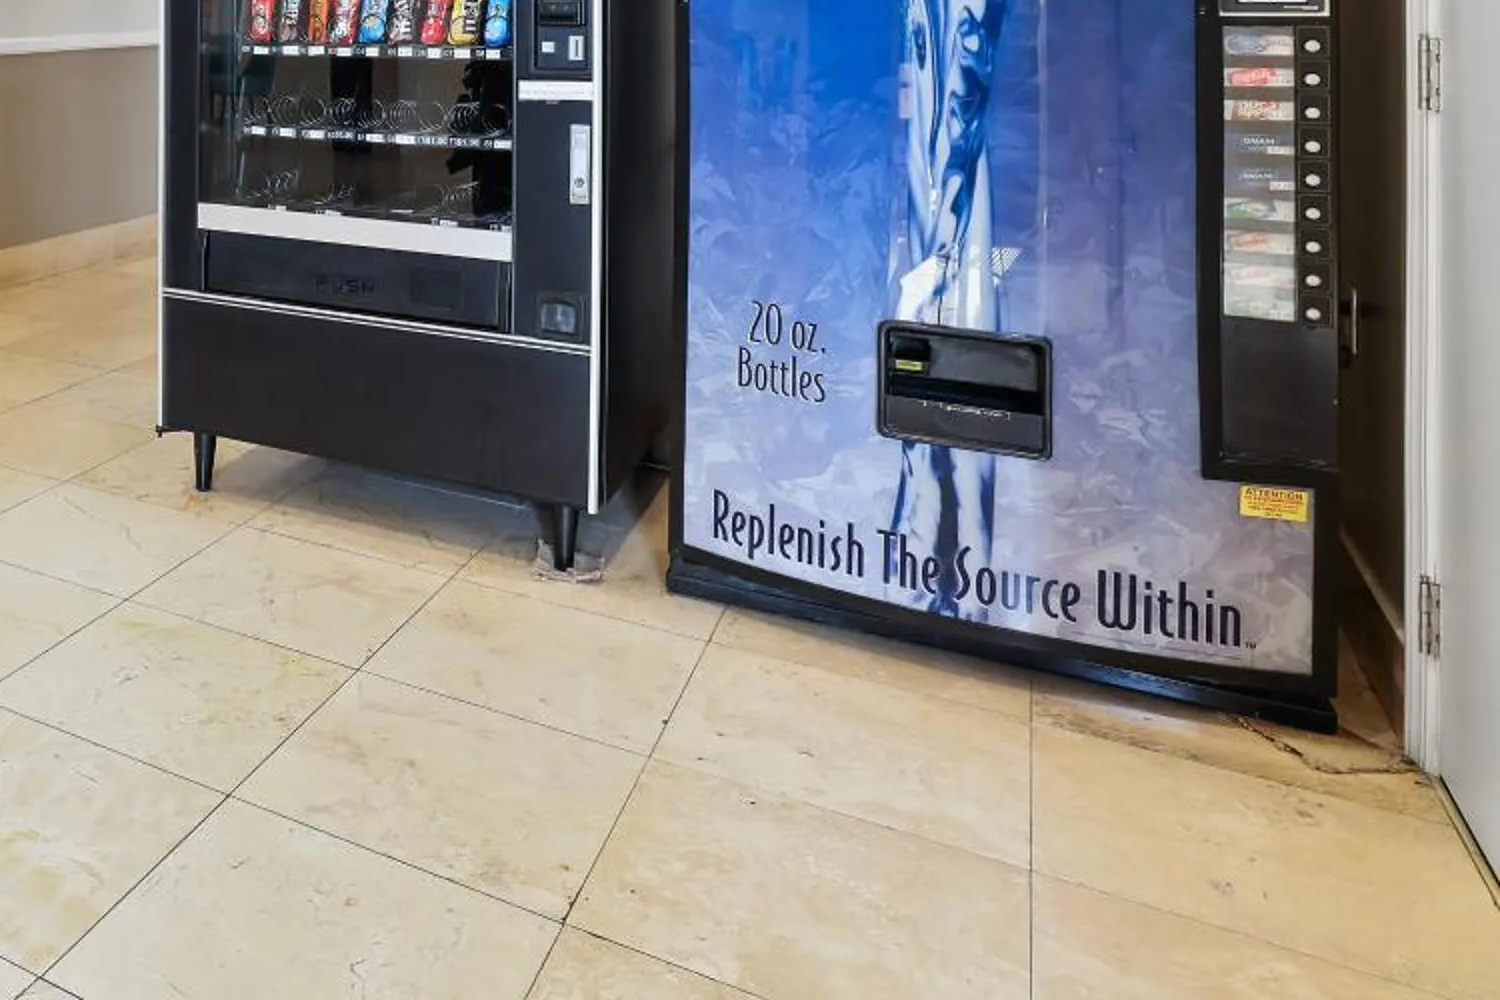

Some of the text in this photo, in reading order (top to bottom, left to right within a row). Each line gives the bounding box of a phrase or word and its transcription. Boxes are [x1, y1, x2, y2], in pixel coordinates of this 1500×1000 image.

[748, 300, 826, 354] 20 oz.
[738, 346, 826, 403] Bottles
[712, 488, 865, 578] Replenish
[876, 529, 941, 594] The
[953, 545, 1081, 623] Source
[1097, 569, 1242, 648] Within
